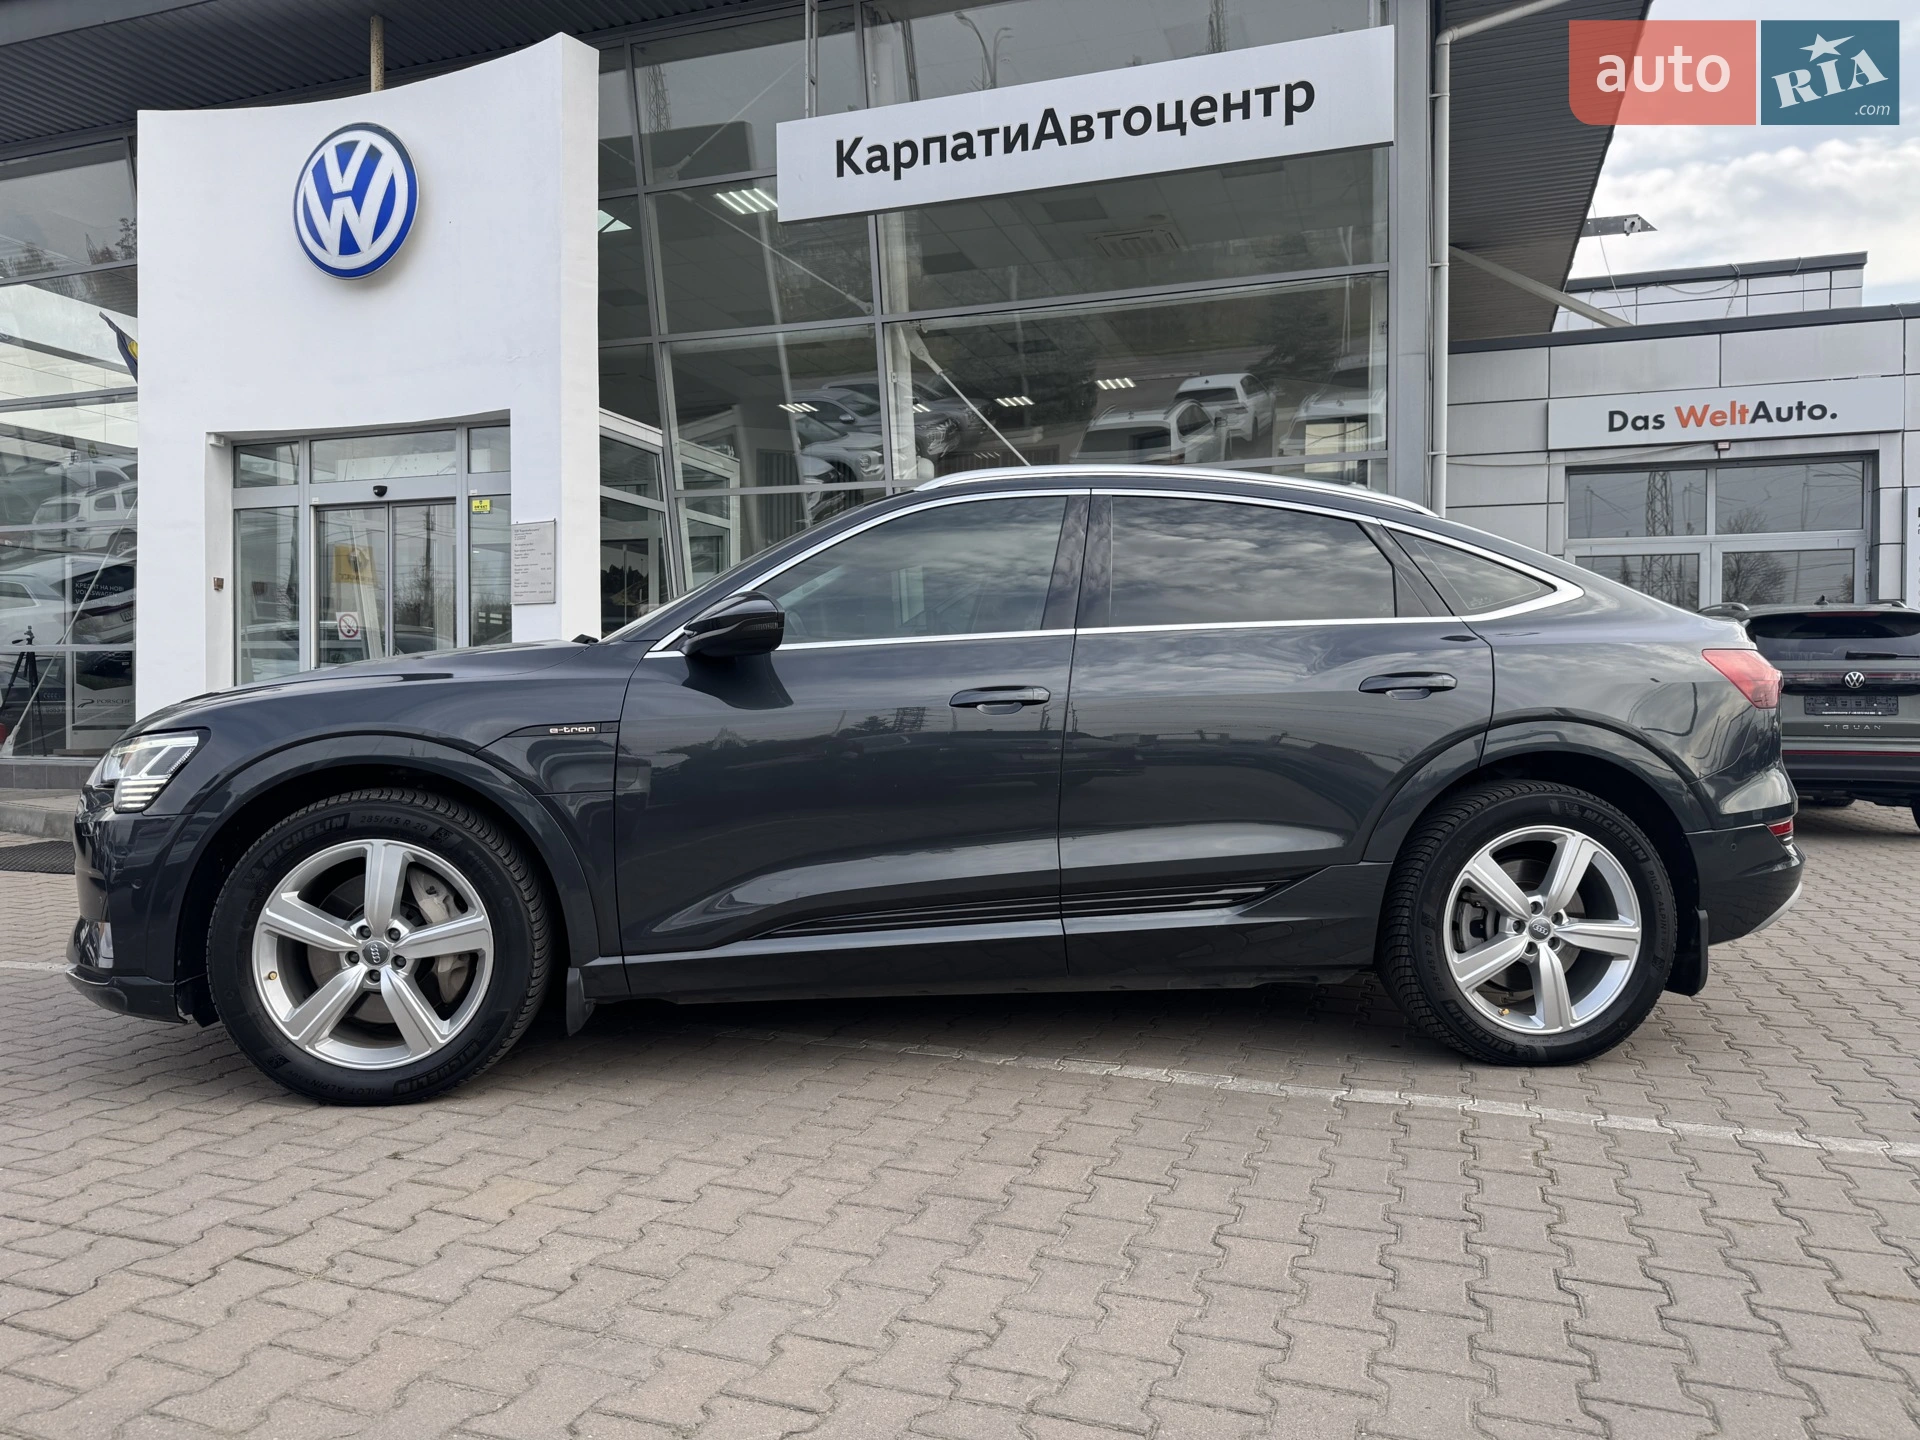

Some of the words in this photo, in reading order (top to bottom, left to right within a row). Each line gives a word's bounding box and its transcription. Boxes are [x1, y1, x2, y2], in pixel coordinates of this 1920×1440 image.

[835, 80, 1315, 181] КарпатиАвтоцентр
[299, 133, 406, 262] VW
[1608, 409, 1666, 433] Das
[1674, 400, 1838, 429] WeltAuto.
[75, 589, 118, 597] VOLSWAGE
[549, 726, 596, 734] e-tron
[360, 815, 401, 826] 285/45
[403, 819, 411, 828] R
[413, 822, 428, 832] 20
[1582, 808, 1648, 861] MICHELIN
[261, 815, 346, 866] MICHELIN
[1647, 870, 1663, 896] PILOT
